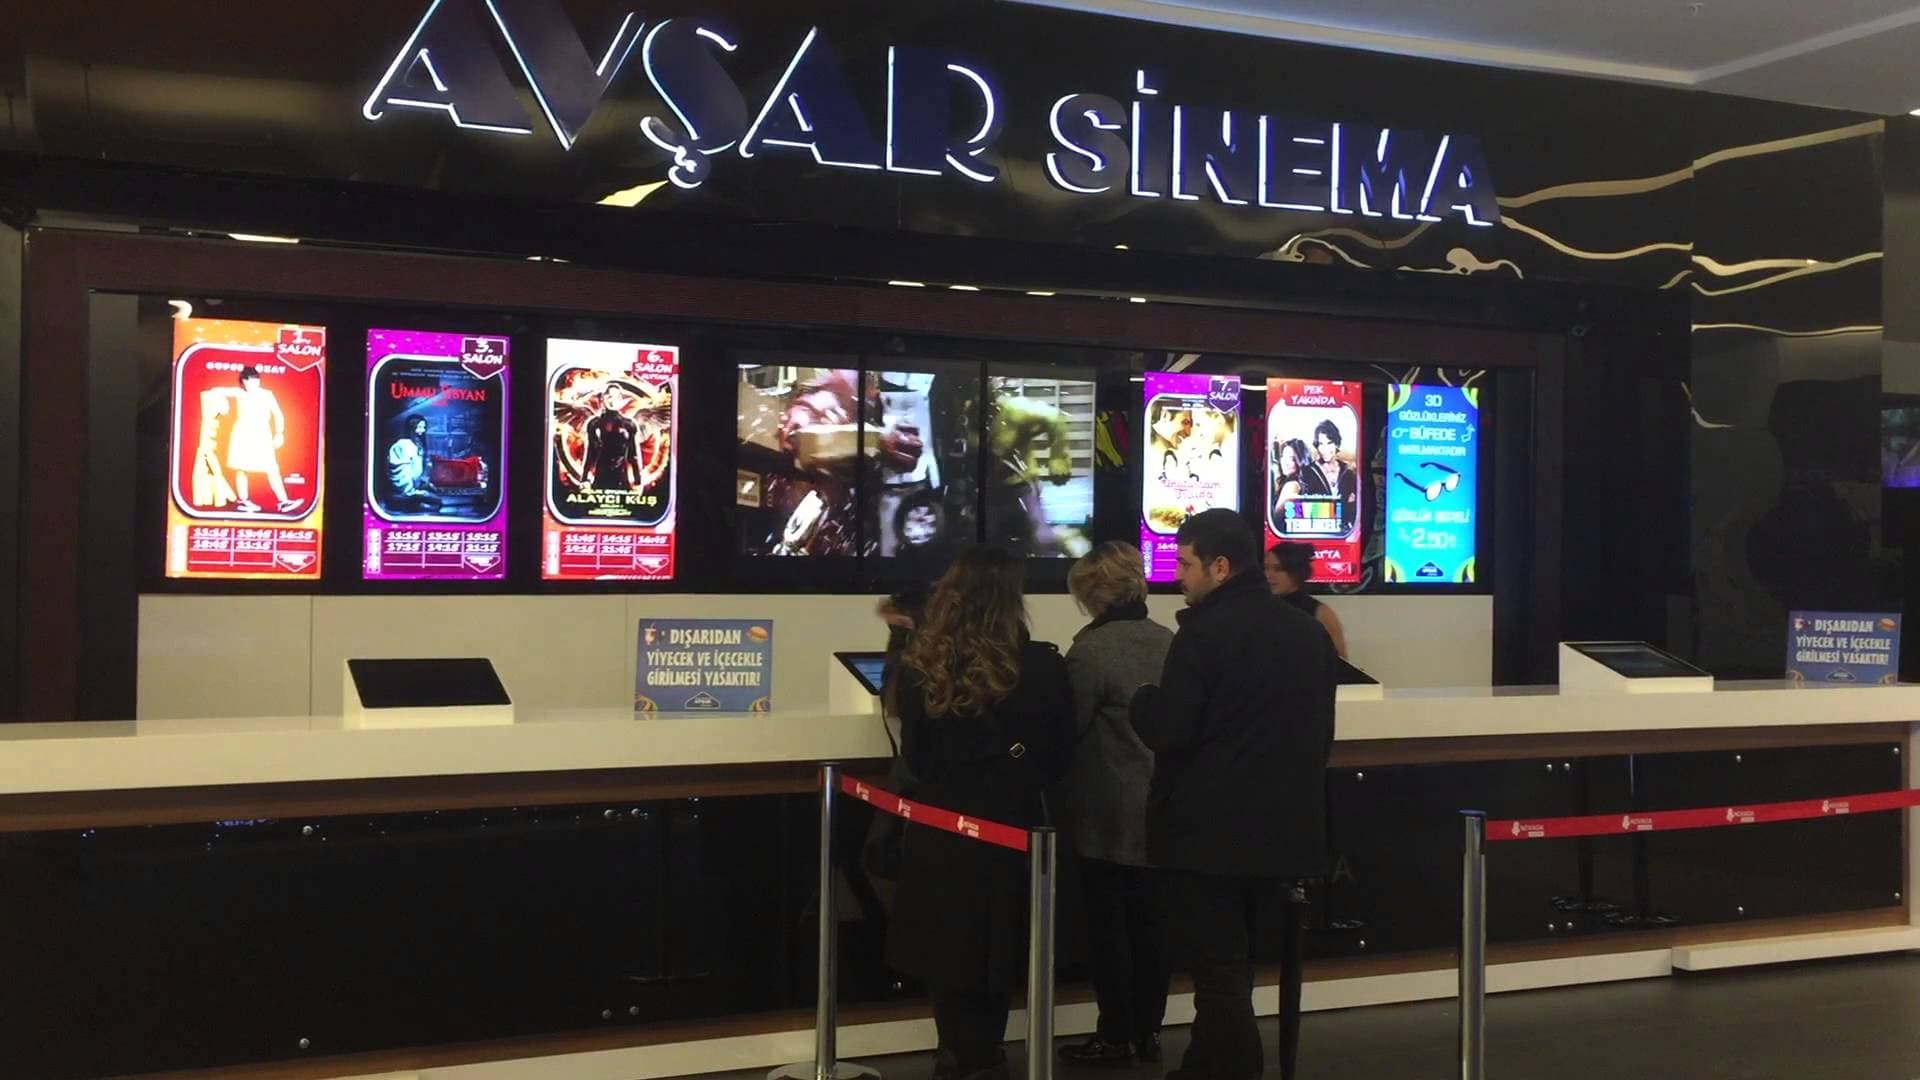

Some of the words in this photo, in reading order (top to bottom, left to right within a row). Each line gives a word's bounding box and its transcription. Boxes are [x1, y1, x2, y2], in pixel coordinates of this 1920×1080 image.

[362, 0, 1002, 190] AVŞAR
[1045, 68, 1497, 228] SİNEMA
[278, 344, 321, 356] SALON
[475, 338, 493, 353] 3.
[462, 353, 503, 365] SALON
[647, 350, 664, 363] 6.
[634, 362, 673, 373] SALON
[1219, 380, 1232, 392] 7.
[1303, 384, 1324, 394] PEK
[1209, 391, 1239, 401] SALON
[1291, 394, 1336, 406] YAKINDA
[1424, 394, 1442, 407] 3D
[1409, 425, 1457, 441] BÜFEDE
[566, 493, 621, 504] ALAYCI
[625, 495, 657, 507] KUŞ
[1814, 619, 1874, 635] DIŞARIDAN
[670, 629, 742, 648] DIŞARIDAN
[1795, 634, 1834, 649] YİYECEK
[1836, 637, 1848, 649] VE
[1850, 636, 1891, 652] İÇECEKLE
[647, 648, 694, 667] YİYECEK
[697, 652, 712, 666] VE
[713, 649, 763, 670] İÇECEKLE
[1795, 649, 1839, 663] GİRİLMESİ
[1843, 653, 1888, 665] YASAKTIR!
[647, 668, 701, 686] GİRİLMESİ
[704, 671, 761, 686] YASAKTIR!
